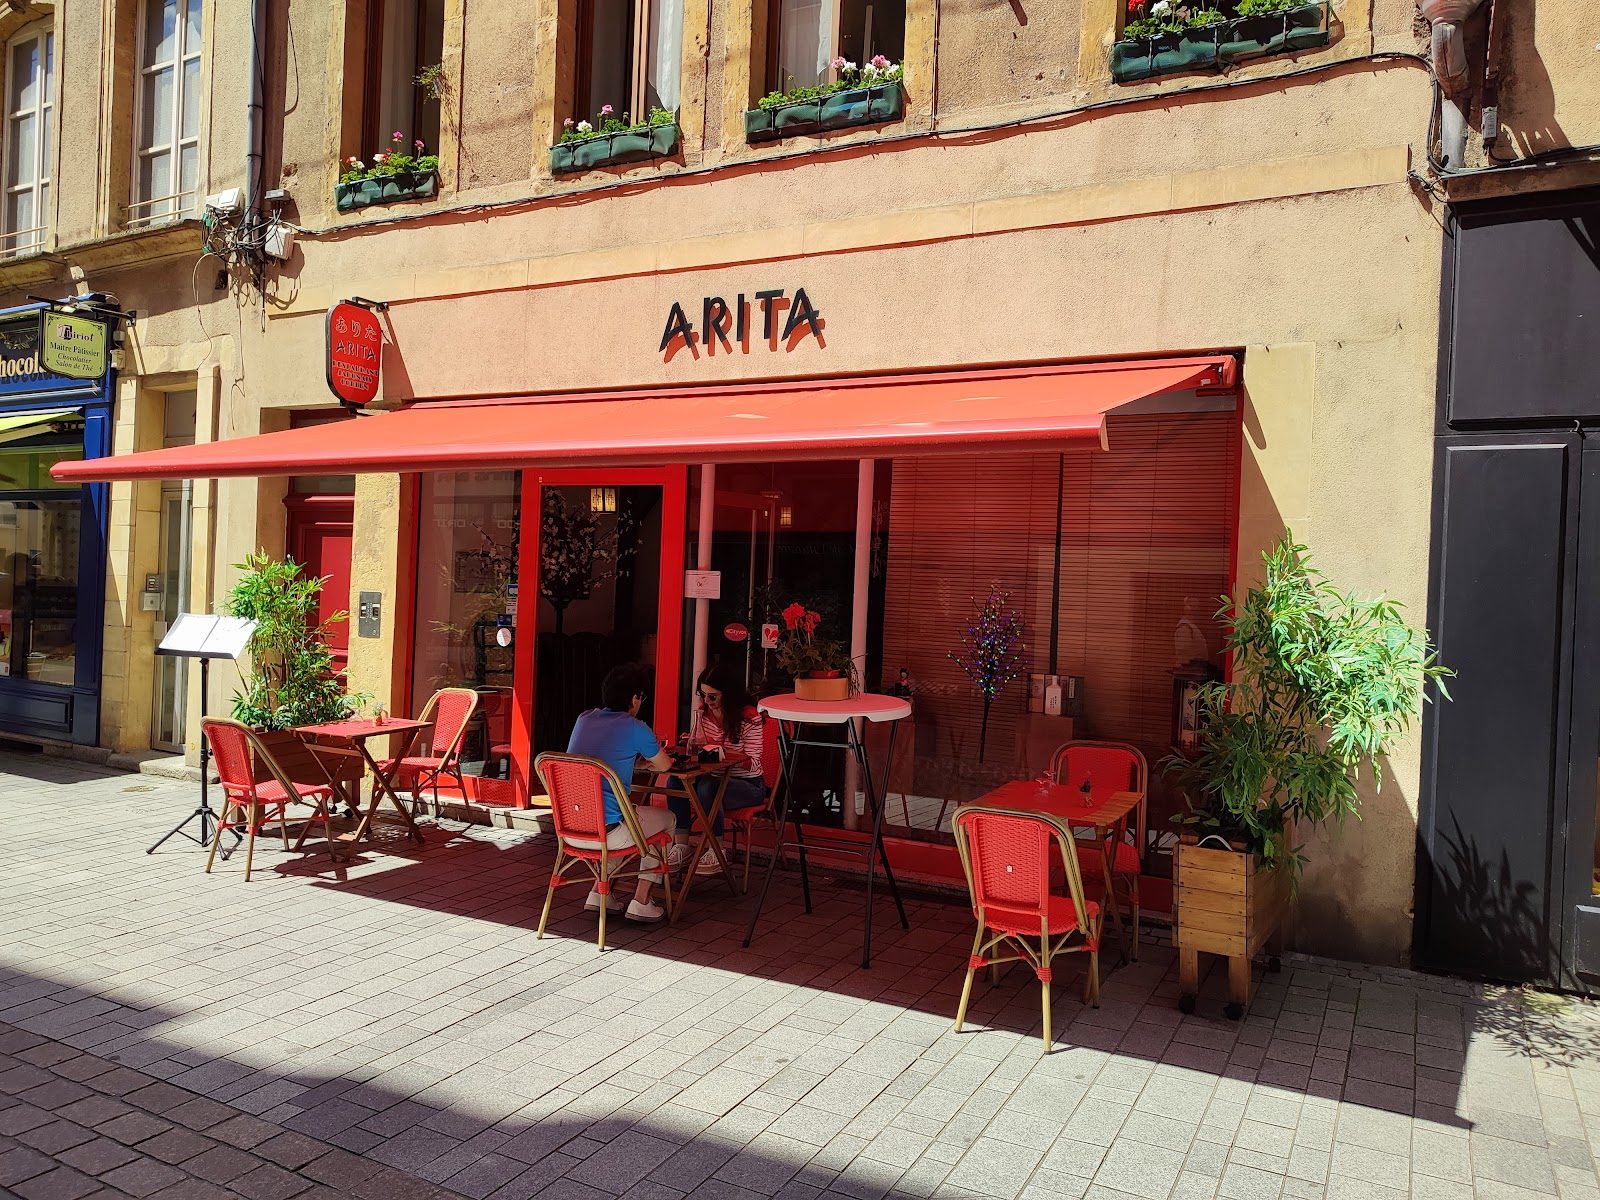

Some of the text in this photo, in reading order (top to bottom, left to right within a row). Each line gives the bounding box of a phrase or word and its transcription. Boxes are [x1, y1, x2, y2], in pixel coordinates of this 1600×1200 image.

[336, 316, 377, 342] ありた
[659, 287, 820, 353] ARITA
[336, 340, 377, 362] ARITA
